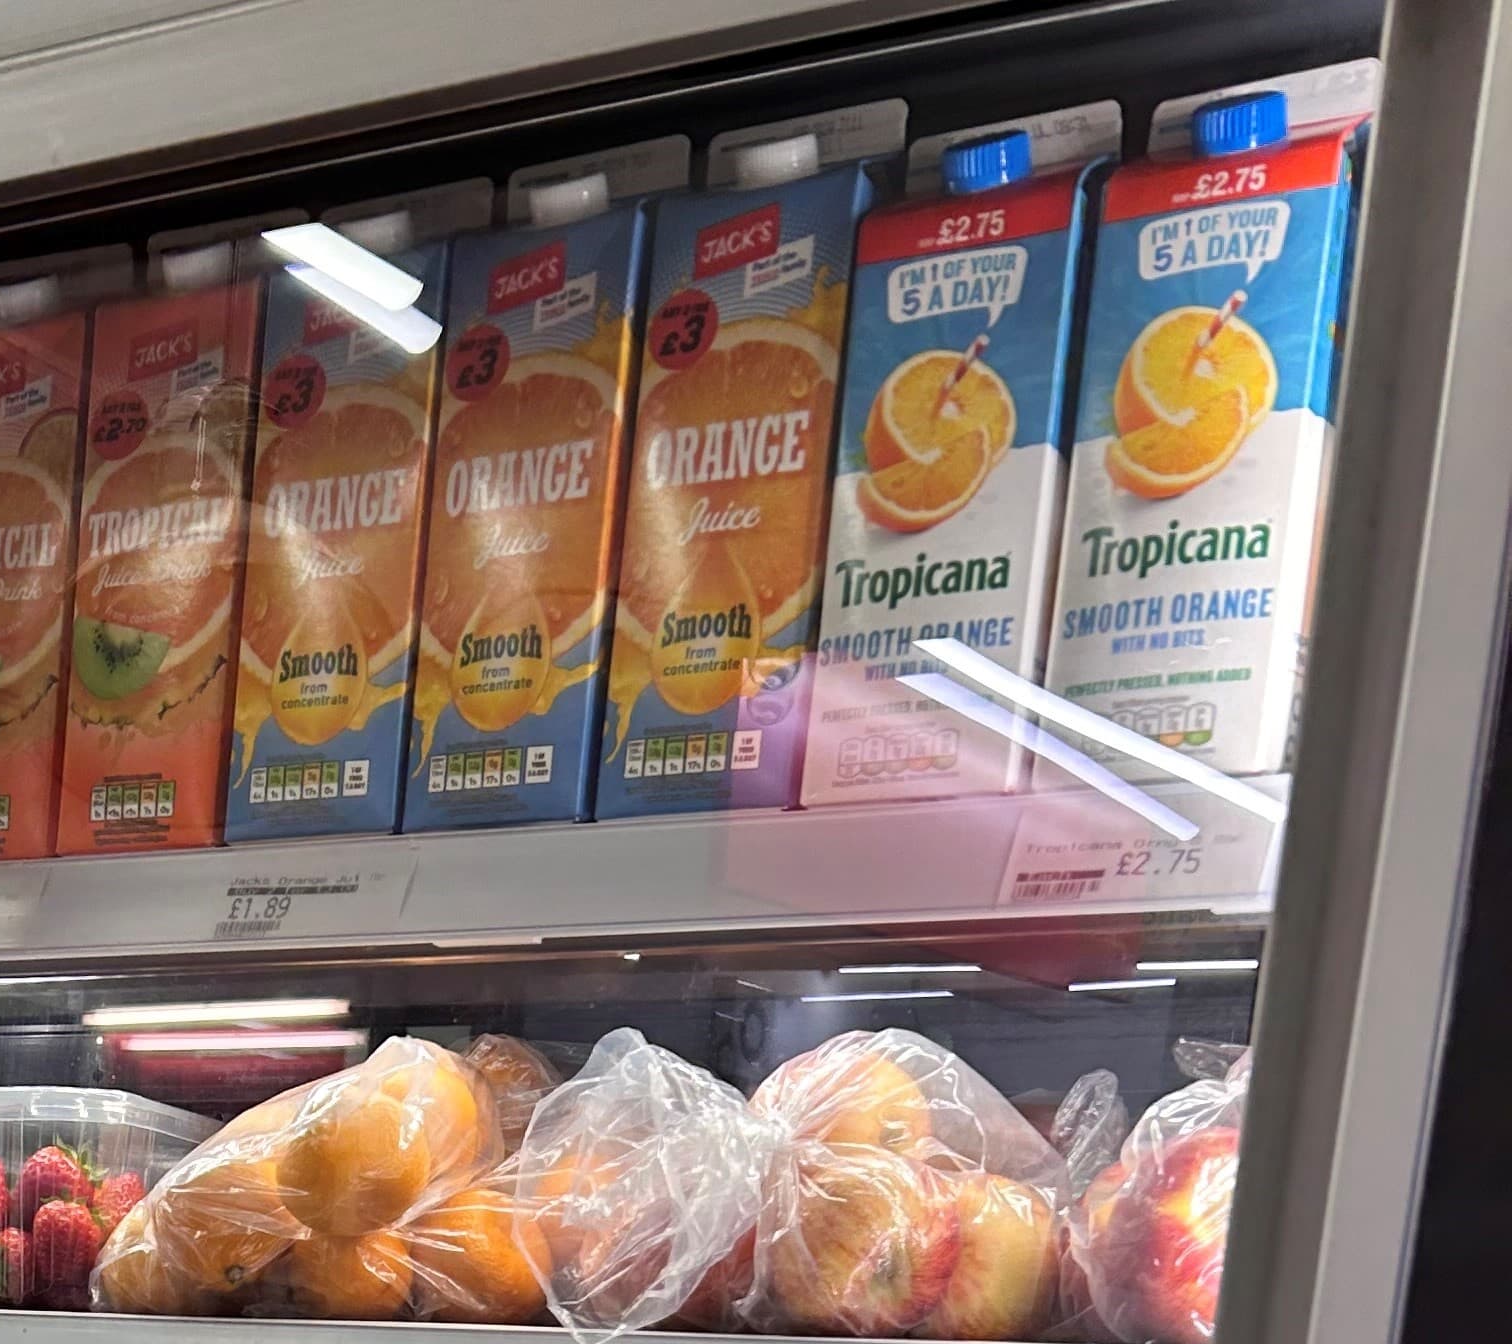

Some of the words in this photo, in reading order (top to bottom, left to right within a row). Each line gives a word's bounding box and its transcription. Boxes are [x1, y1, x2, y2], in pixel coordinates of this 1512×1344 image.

[1191, 164, 1267, 199] £2.75
[703, 220, 773, 261] JACK'S
[938, 209, 1005, 245] £2.75
[1151, 222, 1179, 245] I'M
[1197, 215, 1221, 235] OF
[1227, 207, 1279, 231] YOUR
[899, 265, 925, 288] I'M
[943, 260, 966, 280] OF
[970, 254, 1017, 276] YOUR
[1153, 244, 1174, 271] 5
[1181, 243, 1198, 267] A
[1206, 231, 1269, 262] DAY!
[495, 261, 560, 298] JACK'S
[901, 288, 921, 315] 5
[927, 287, 943, 311] A
[952, 275, 1010, 307] DAY!
[648, 410, 809, 492] ORANGE
[446, 439, 595, 517] ORANGE
[265, 468, 407, 538] ORANGE
[678, 496, 761, 545] Juice
[90, 498, 228, 557] TROPICAL
[474, 523, 549, 569] Juice
[1082, 519, 1270, 579] Tropicana
[835, 553, 1011, 610] Tropicana
[663, 604, 752, 647] Smooth
[1063, 597, 1161, 640] SMOOTH
[1170, 588, 1274, 623] ORANGE
[280, 645, 358, 681] Smooth
[460, 624, 543, 666] Smooth
[685, 645, 716, 661] from
[819, 626, 911, 668] SMOOTH
[462, 676, 533, 695] concentrate
[481, 664, 511, 680] from
[663, 657, 741, 676] concentrate
[1116, 848, 1201, 876] £2.75
[229, 897, 290, 919] £1.89
